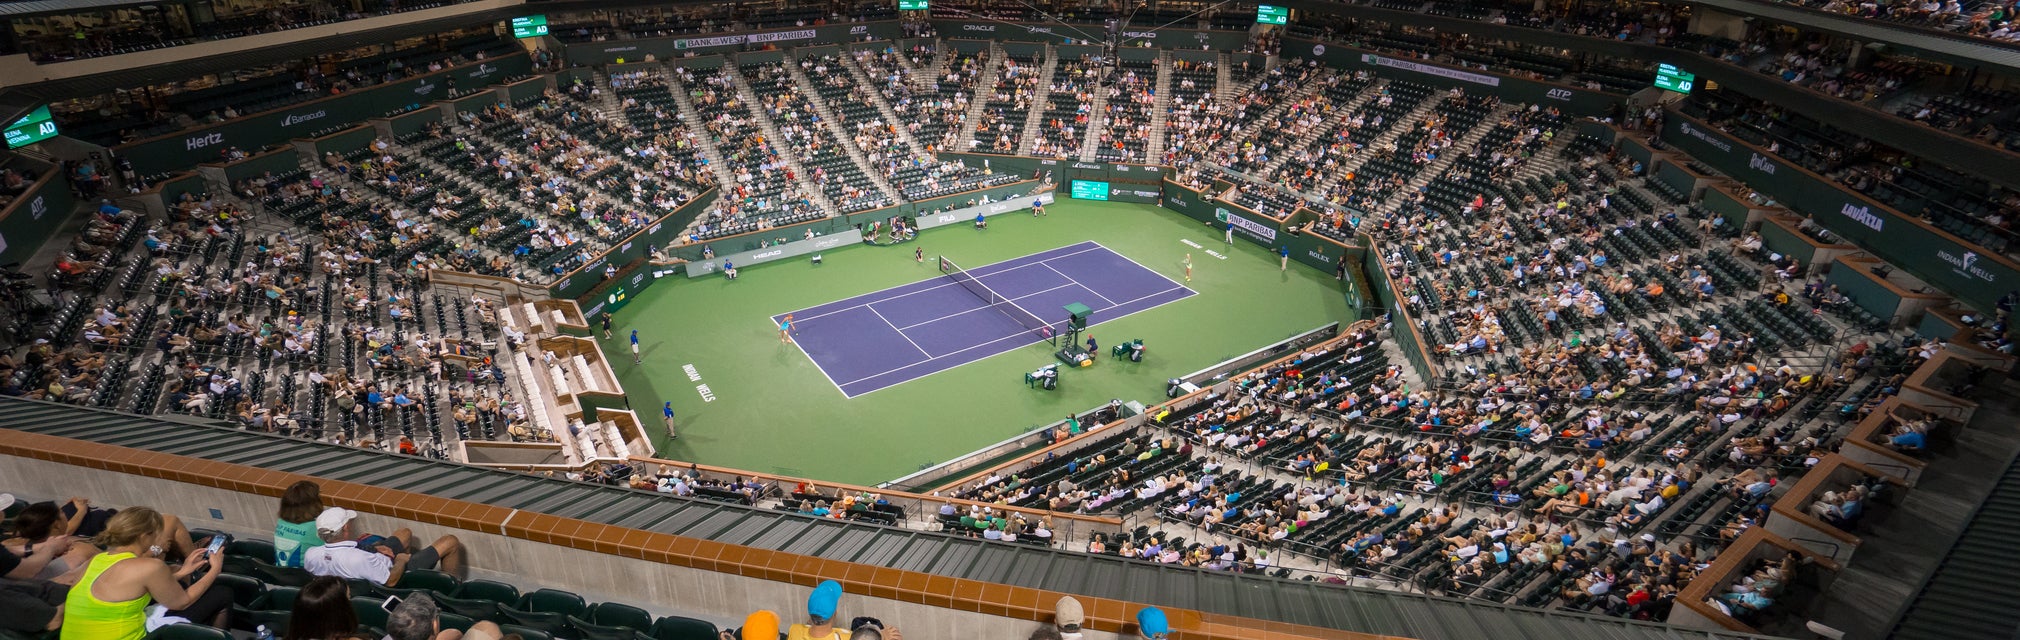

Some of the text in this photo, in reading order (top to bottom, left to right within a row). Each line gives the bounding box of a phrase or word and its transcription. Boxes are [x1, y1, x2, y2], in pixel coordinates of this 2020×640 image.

[536, 25, 547, 34] AD
[850, 25, 867, 33] ATP
[963, 24, 995, 32] ORACLE
[687, 39, 711, 47] BANK
[720, 36, 743, 44] WEST
[756, 30, 815, 42] BNP PARIBAS
[1378, 57, 1390, 65] BNP
[1391, 60, 1417, 70] PARIBAS
[1677, 80, 1692, 91] AD
[1547, 88, 1572, 98] ATP
[291, 110, 326, 125] Barracuda
[39, 121, 56, 136] AD
[186, 132, 222, 151] Hertz
[31, 195, 44, 216] ATP
[1171, 197, 1187, 208] ROLEX
[939, 214, 956, 223] FILA
[1841, 203, 1883, 232] LAVAZZA
[1229, 214, 1273, 238] BNP PARIBAS
[753, 250, 782, 260] HEAD
[1205, 249, 1228, 260] WELLS
[1309, 250, 1330, 263] ROLEX
[585, 255, 607, 273] ORACLE
[1936, 250, 1961, 267] INDIAN
[1970, 265, 1995, 282] WELLS
[559, 278, 571, 289] ATP
[682, 363, 716, 403] INDIAN WELLS
